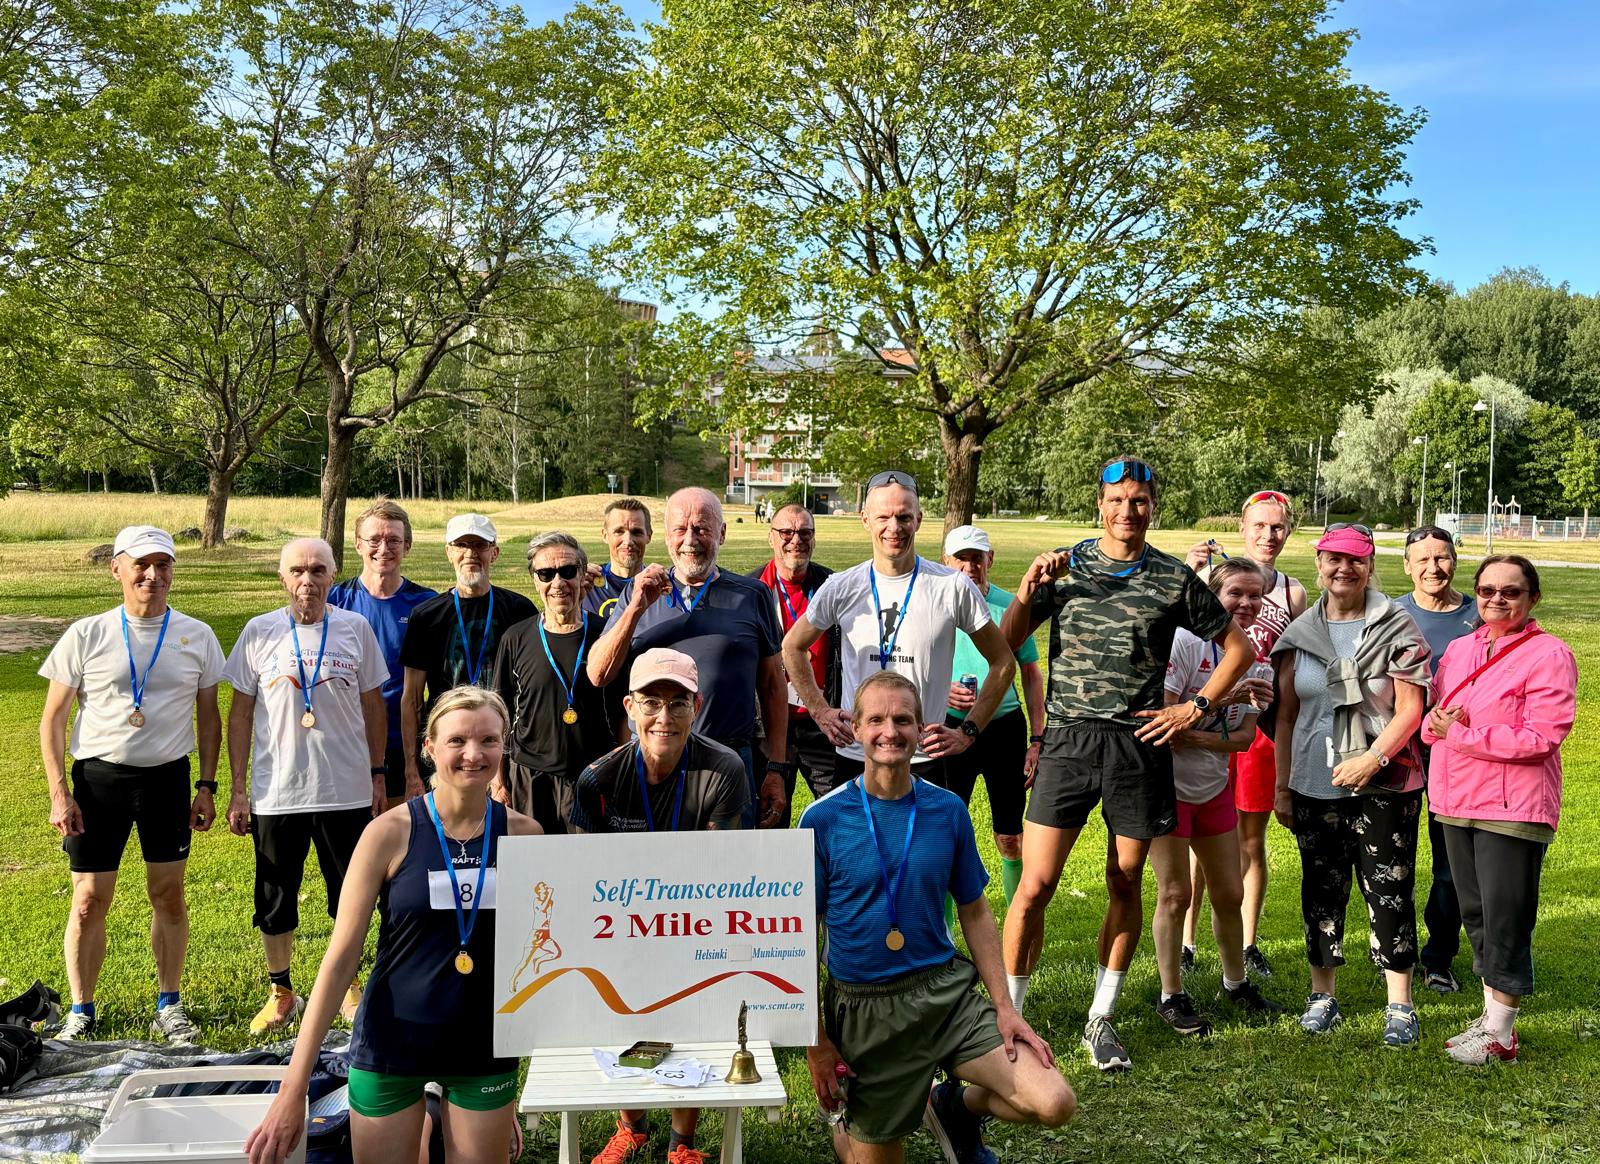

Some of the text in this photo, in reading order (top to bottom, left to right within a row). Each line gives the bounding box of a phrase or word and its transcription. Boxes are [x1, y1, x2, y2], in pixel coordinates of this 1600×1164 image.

[289, 660, 297, 668] 2
[461, 883, 473, 902] 8
[592, 875, 804, 907] Self-Transcendence
[593, 909, 804, 939] 2 Mile Run
[695, 946, 806, 960] Helsinki Munkinpuisto
[481, 1081, 510, 1093] CRAFT
